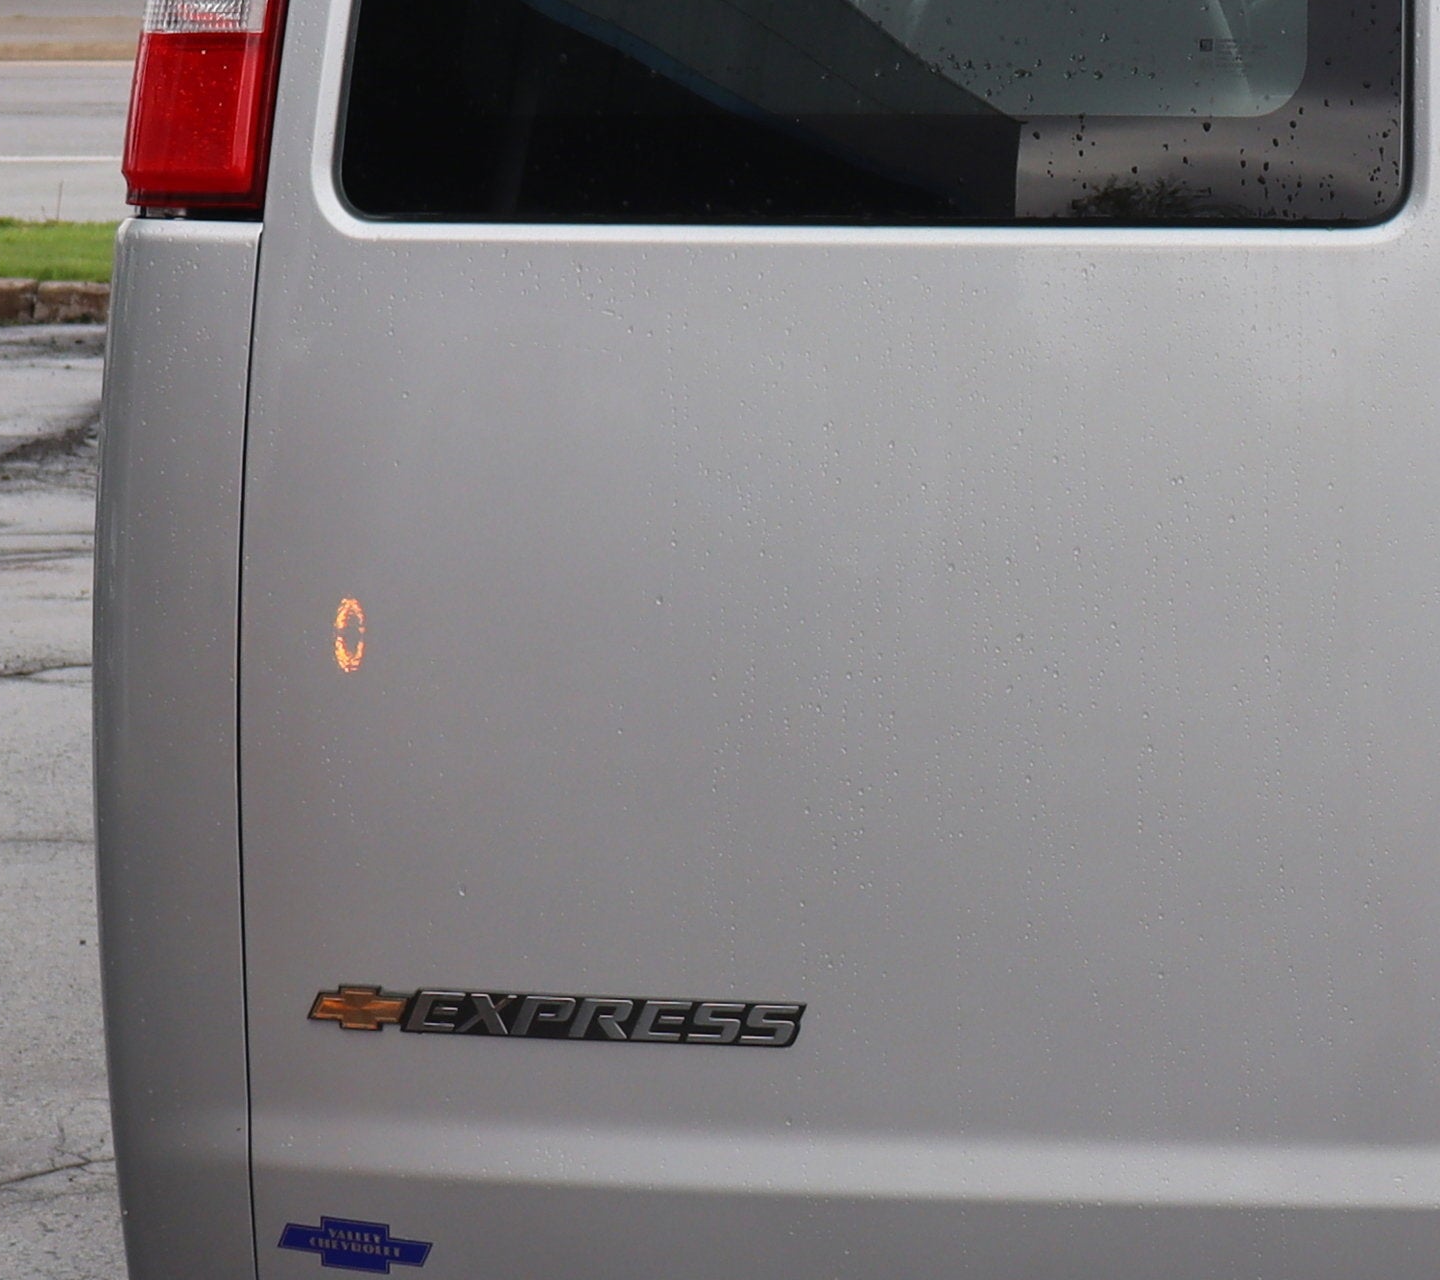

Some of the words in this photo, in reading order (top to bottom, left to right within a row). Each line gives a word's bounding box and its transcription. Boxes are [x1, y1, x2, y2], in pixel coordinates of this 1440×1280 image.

[405, 991, 802, 1048] EXPRESS
[327, 1227, 383, 1244] VALLEY
[309, 1237, 401, 1258] CHEVROLET
